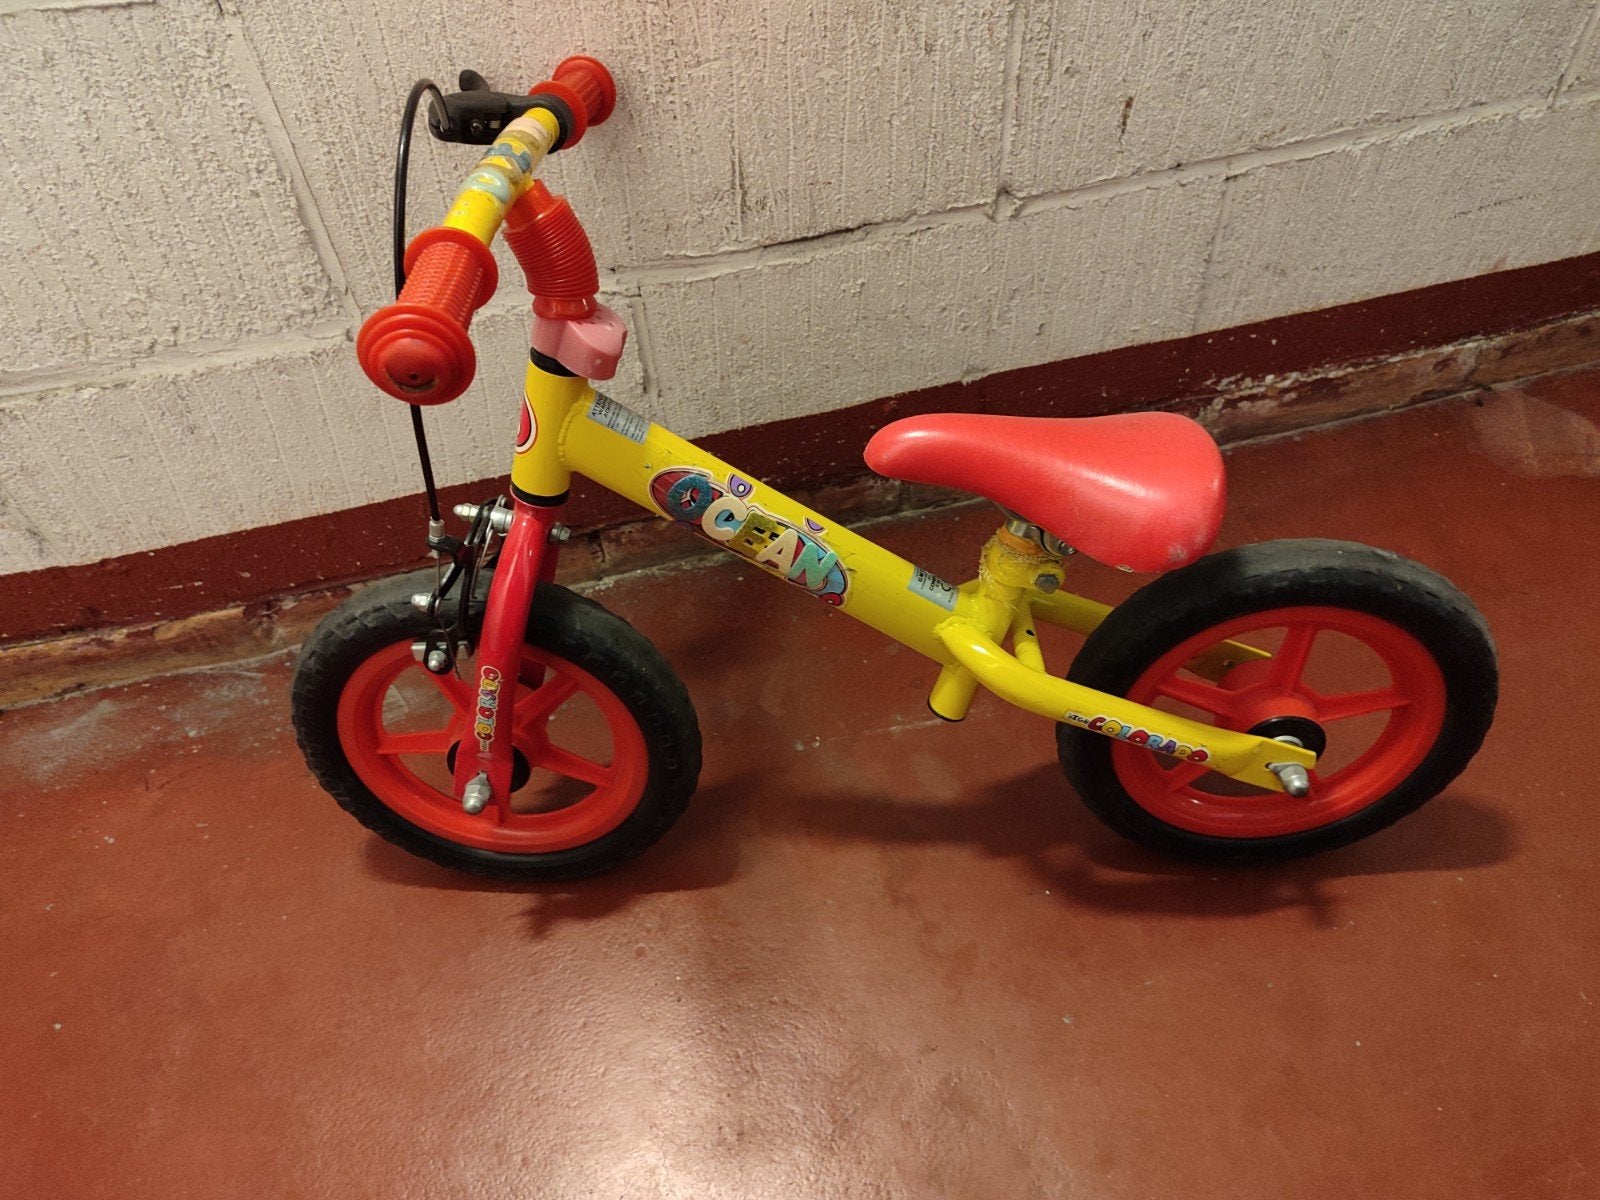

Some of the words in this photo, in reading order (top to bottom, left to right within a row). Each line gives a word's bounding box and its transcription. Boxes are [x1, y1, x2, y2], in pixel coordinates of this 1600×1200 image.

[667, 474, 837, 589] OCEAN
[476, 668, 500, 740] COLORADO
[1088, 716, 1209, 762] COLORADO
